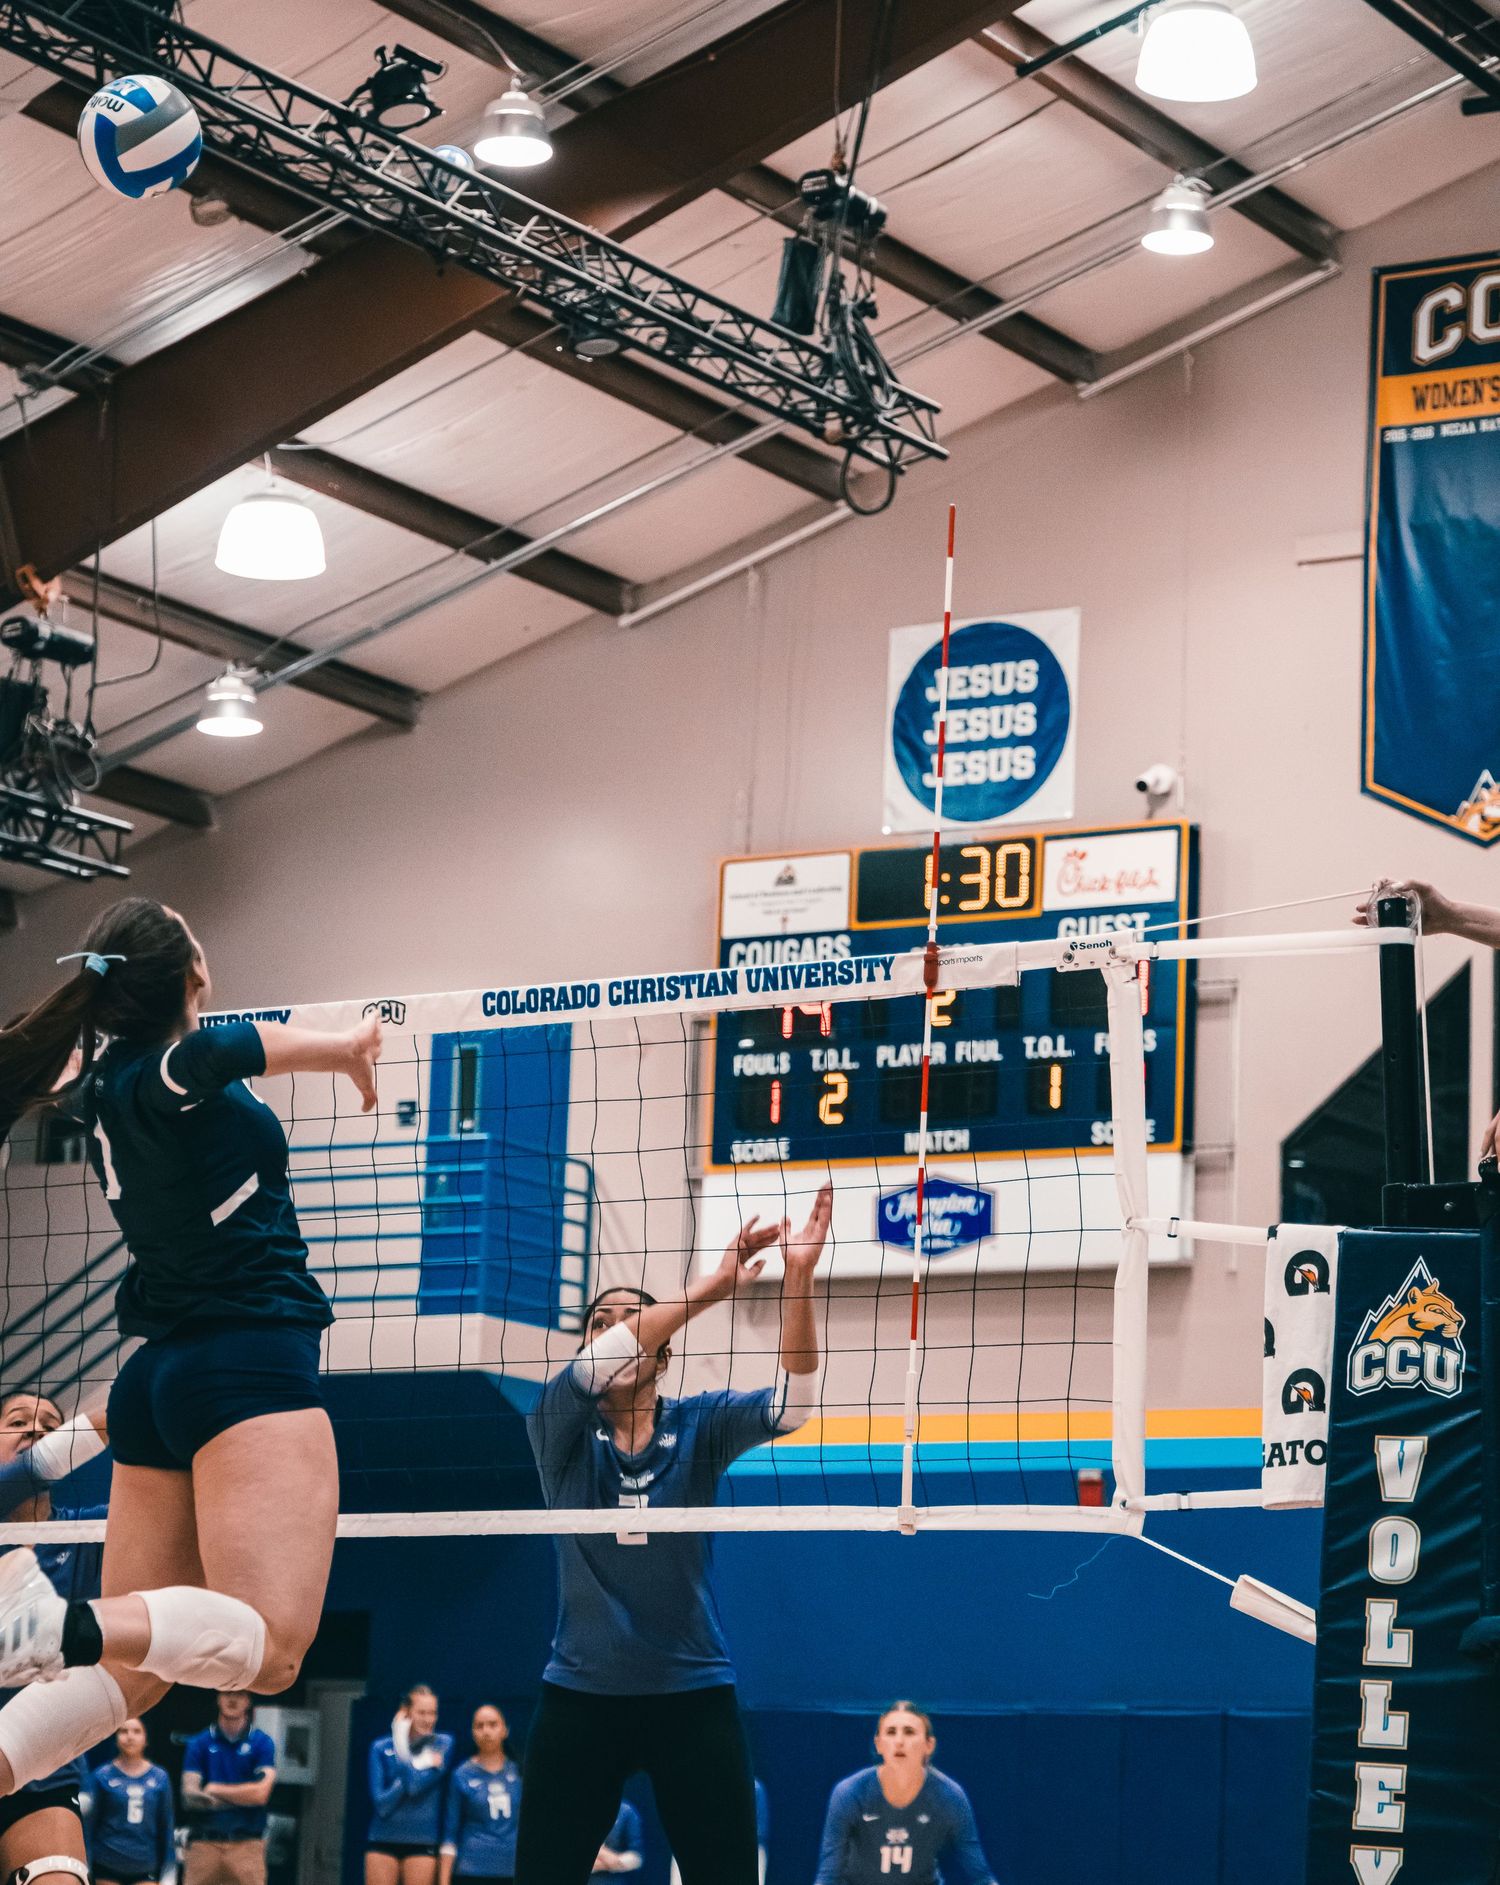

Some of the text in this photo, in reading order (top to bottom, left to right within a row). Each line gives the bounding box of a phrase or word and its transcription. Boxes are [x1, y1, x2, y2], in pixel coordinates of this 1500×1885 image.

[925, 659, 1039, 703] JESUS
[922, 702, 1037, 745] JESUS
[922, 745, 1036, 788] JESUS
[728, 934, 852, 969] COUGARS
[1079, 940, 1113, 950] Senoh
[482, 956, 896, 1017] COLORADO CHRISTIAN UNIVERSITY
[733, 1052, 791, 1077] FOULS
[1050, 1063, 1062, 1109] 1
[770, 1080, 781, 1125] 1
[818, 1072, 849, 1125] 2
[1352, 1339, 1461, 1393] CCU
[880, 1846, 913, 1874] 14
